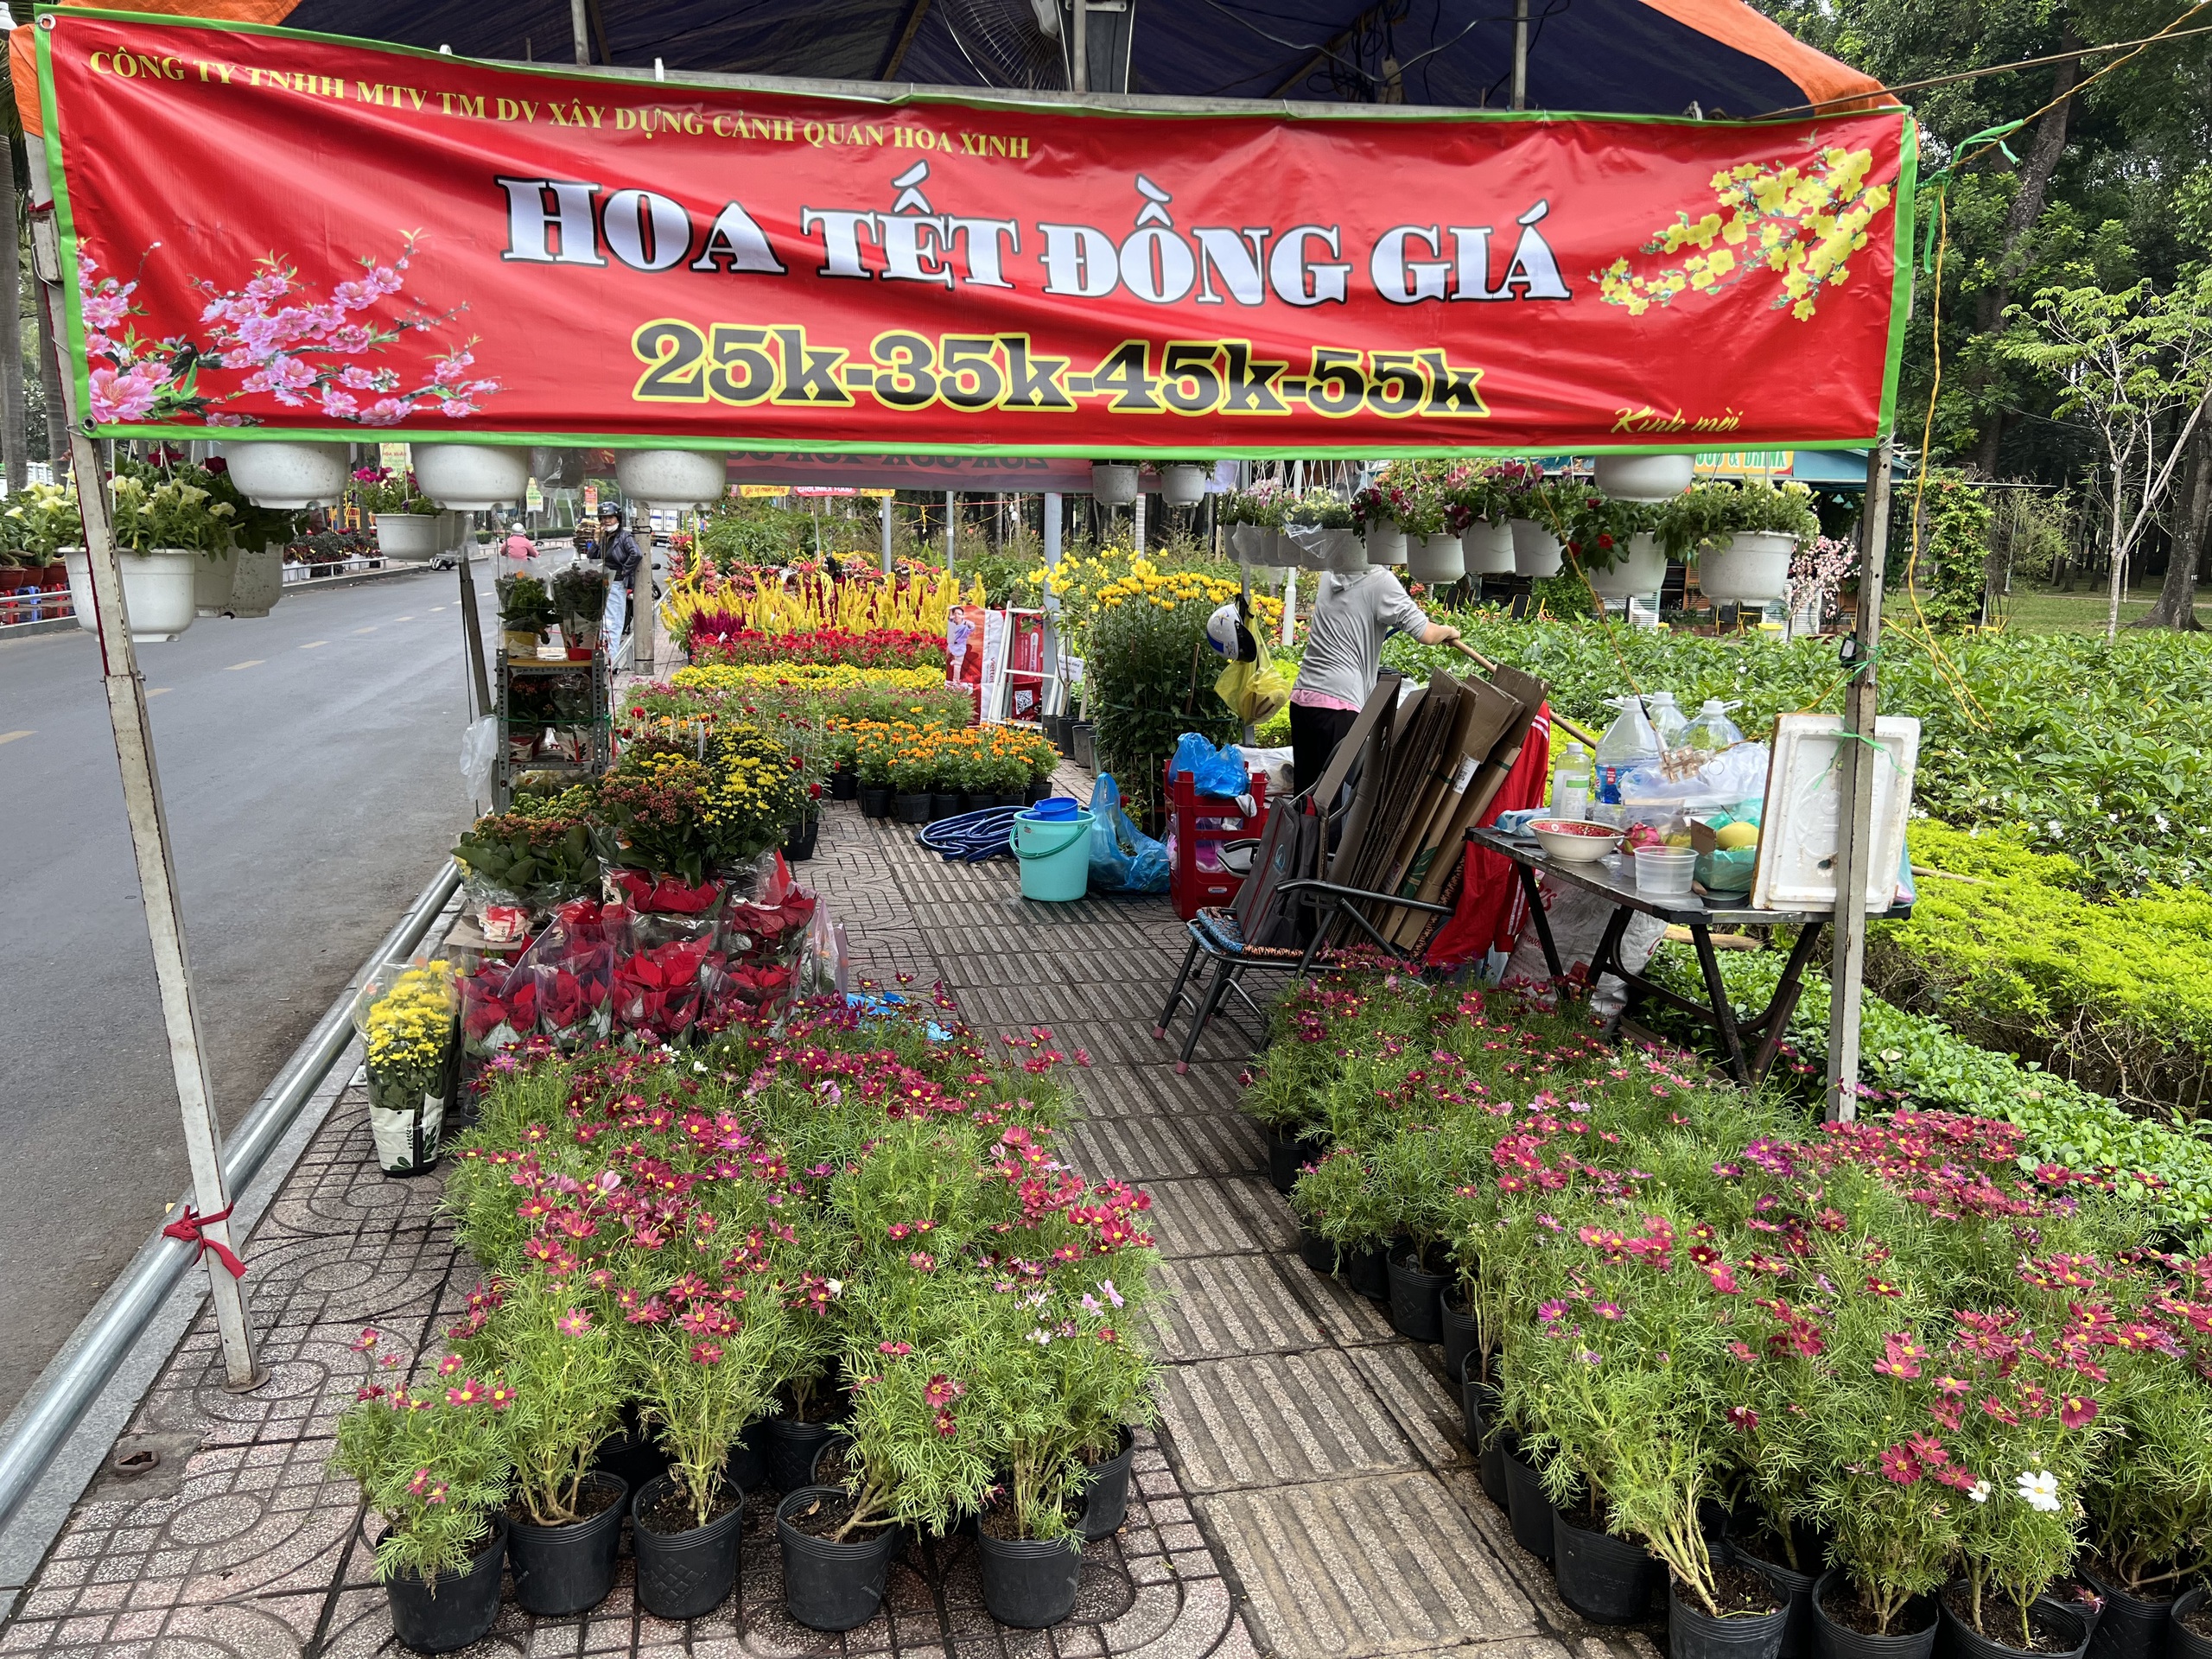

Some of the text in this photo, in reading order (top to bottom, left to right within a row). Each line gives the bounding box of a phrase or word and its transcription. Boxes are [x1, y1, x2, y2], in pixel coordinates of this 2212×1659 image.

[90, 47, 1029, 159] CÔNG TY TNHH MTV TM DV XÂY DỰNG CẢNH QUAN HOA XINH
[493, 159, 1573, 308] HOA TẾT ĐỒNG GIÁ
[631, 319, 1490, 417] 25k-35k-45k-55k
[1610, 405, 1744, 434] Kính mời
